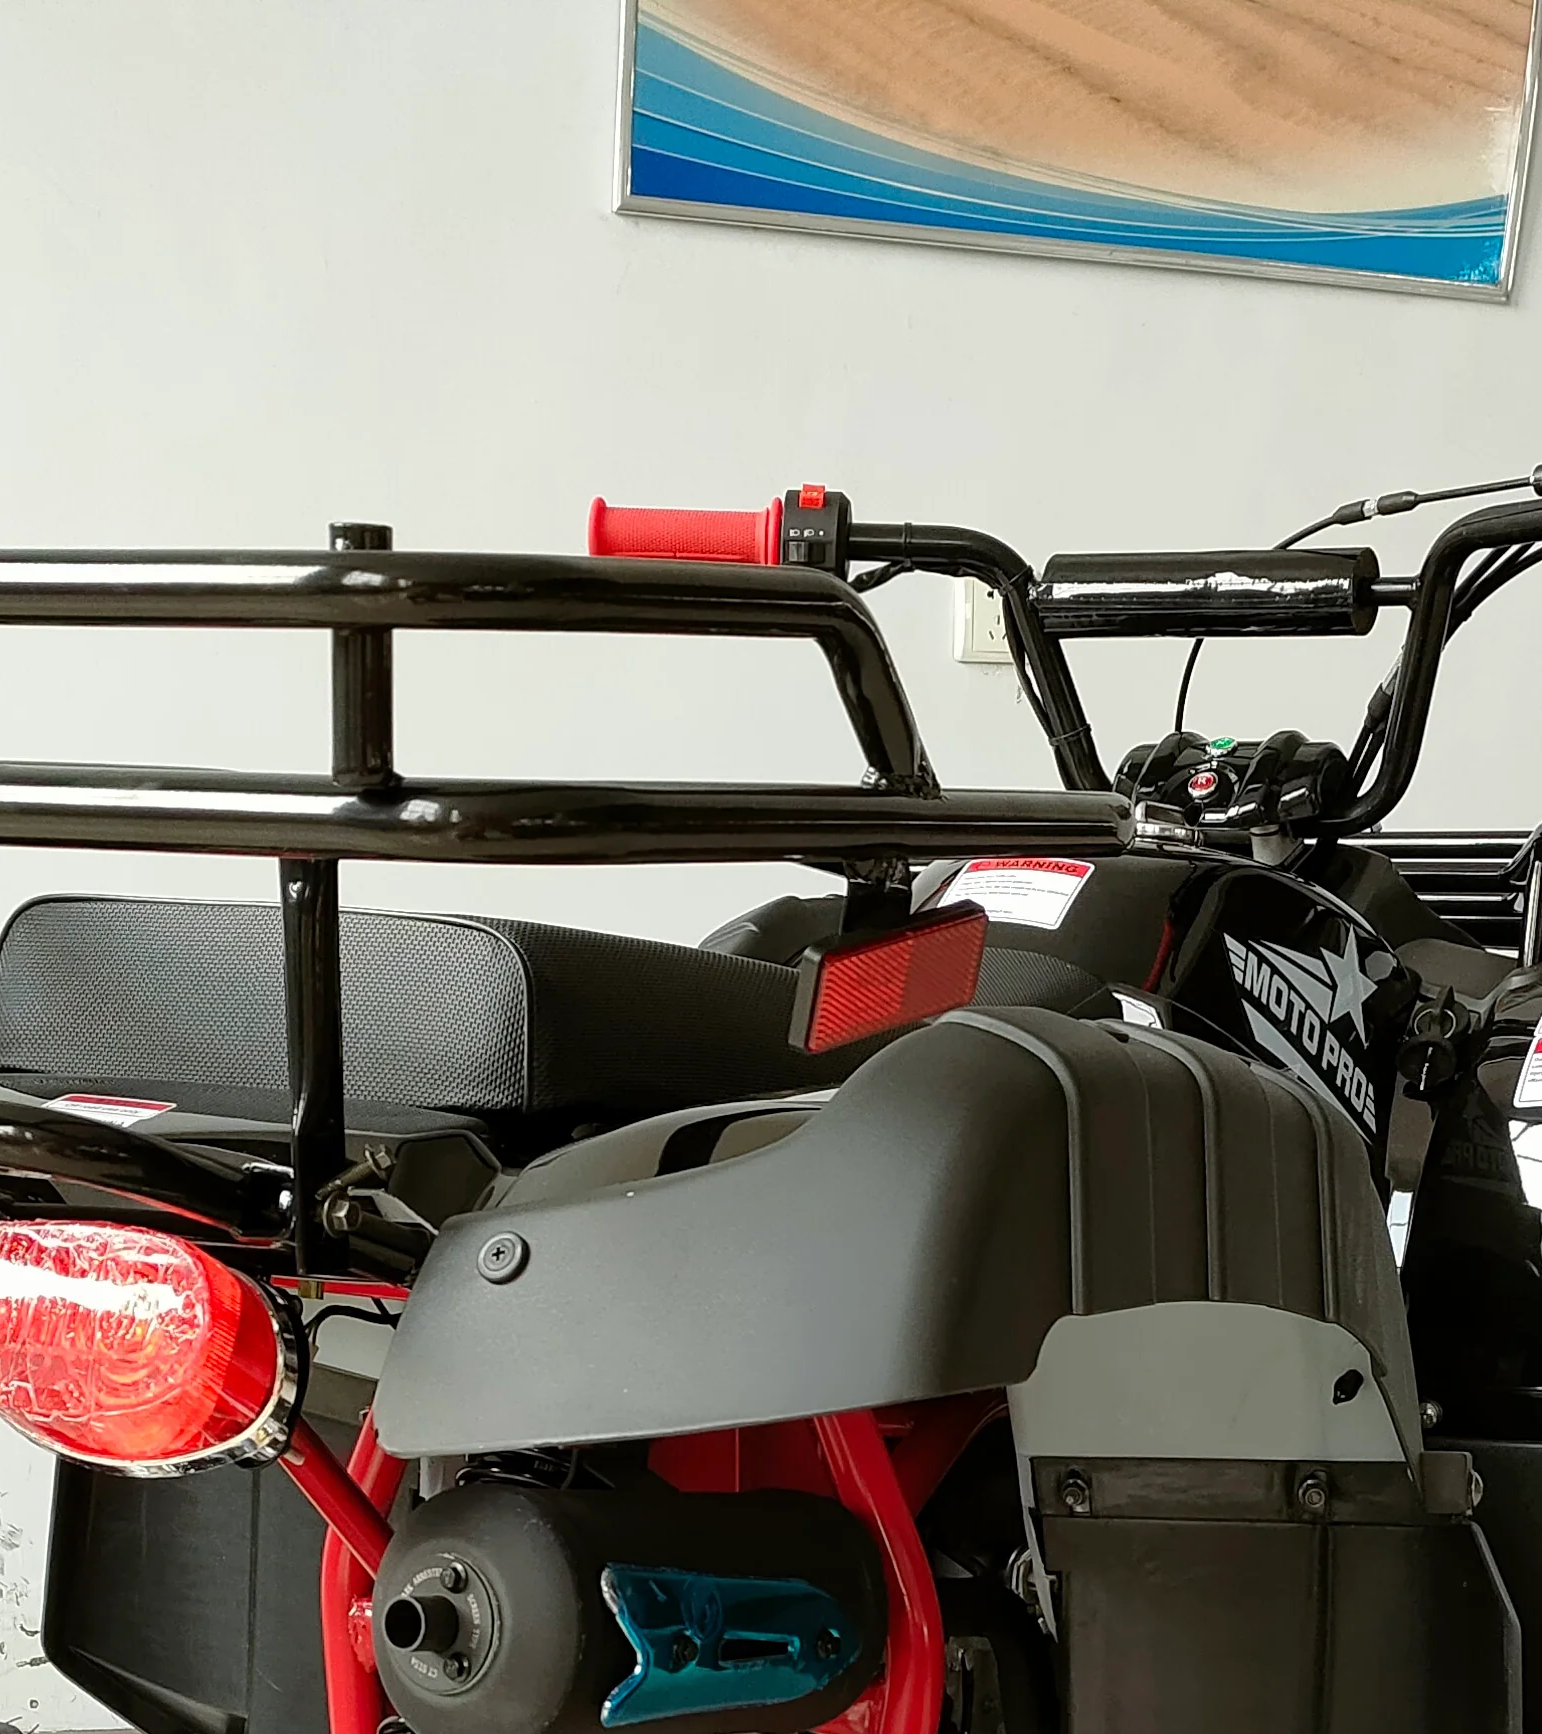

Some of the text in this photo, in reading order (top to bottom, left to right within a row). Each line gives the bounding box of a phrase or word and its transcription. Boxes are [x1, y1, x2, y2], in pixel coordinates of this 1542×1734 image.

[995, 860, 1079, 873] WARNING
[1244, 953, 1368, 1113] MOTO PRO
